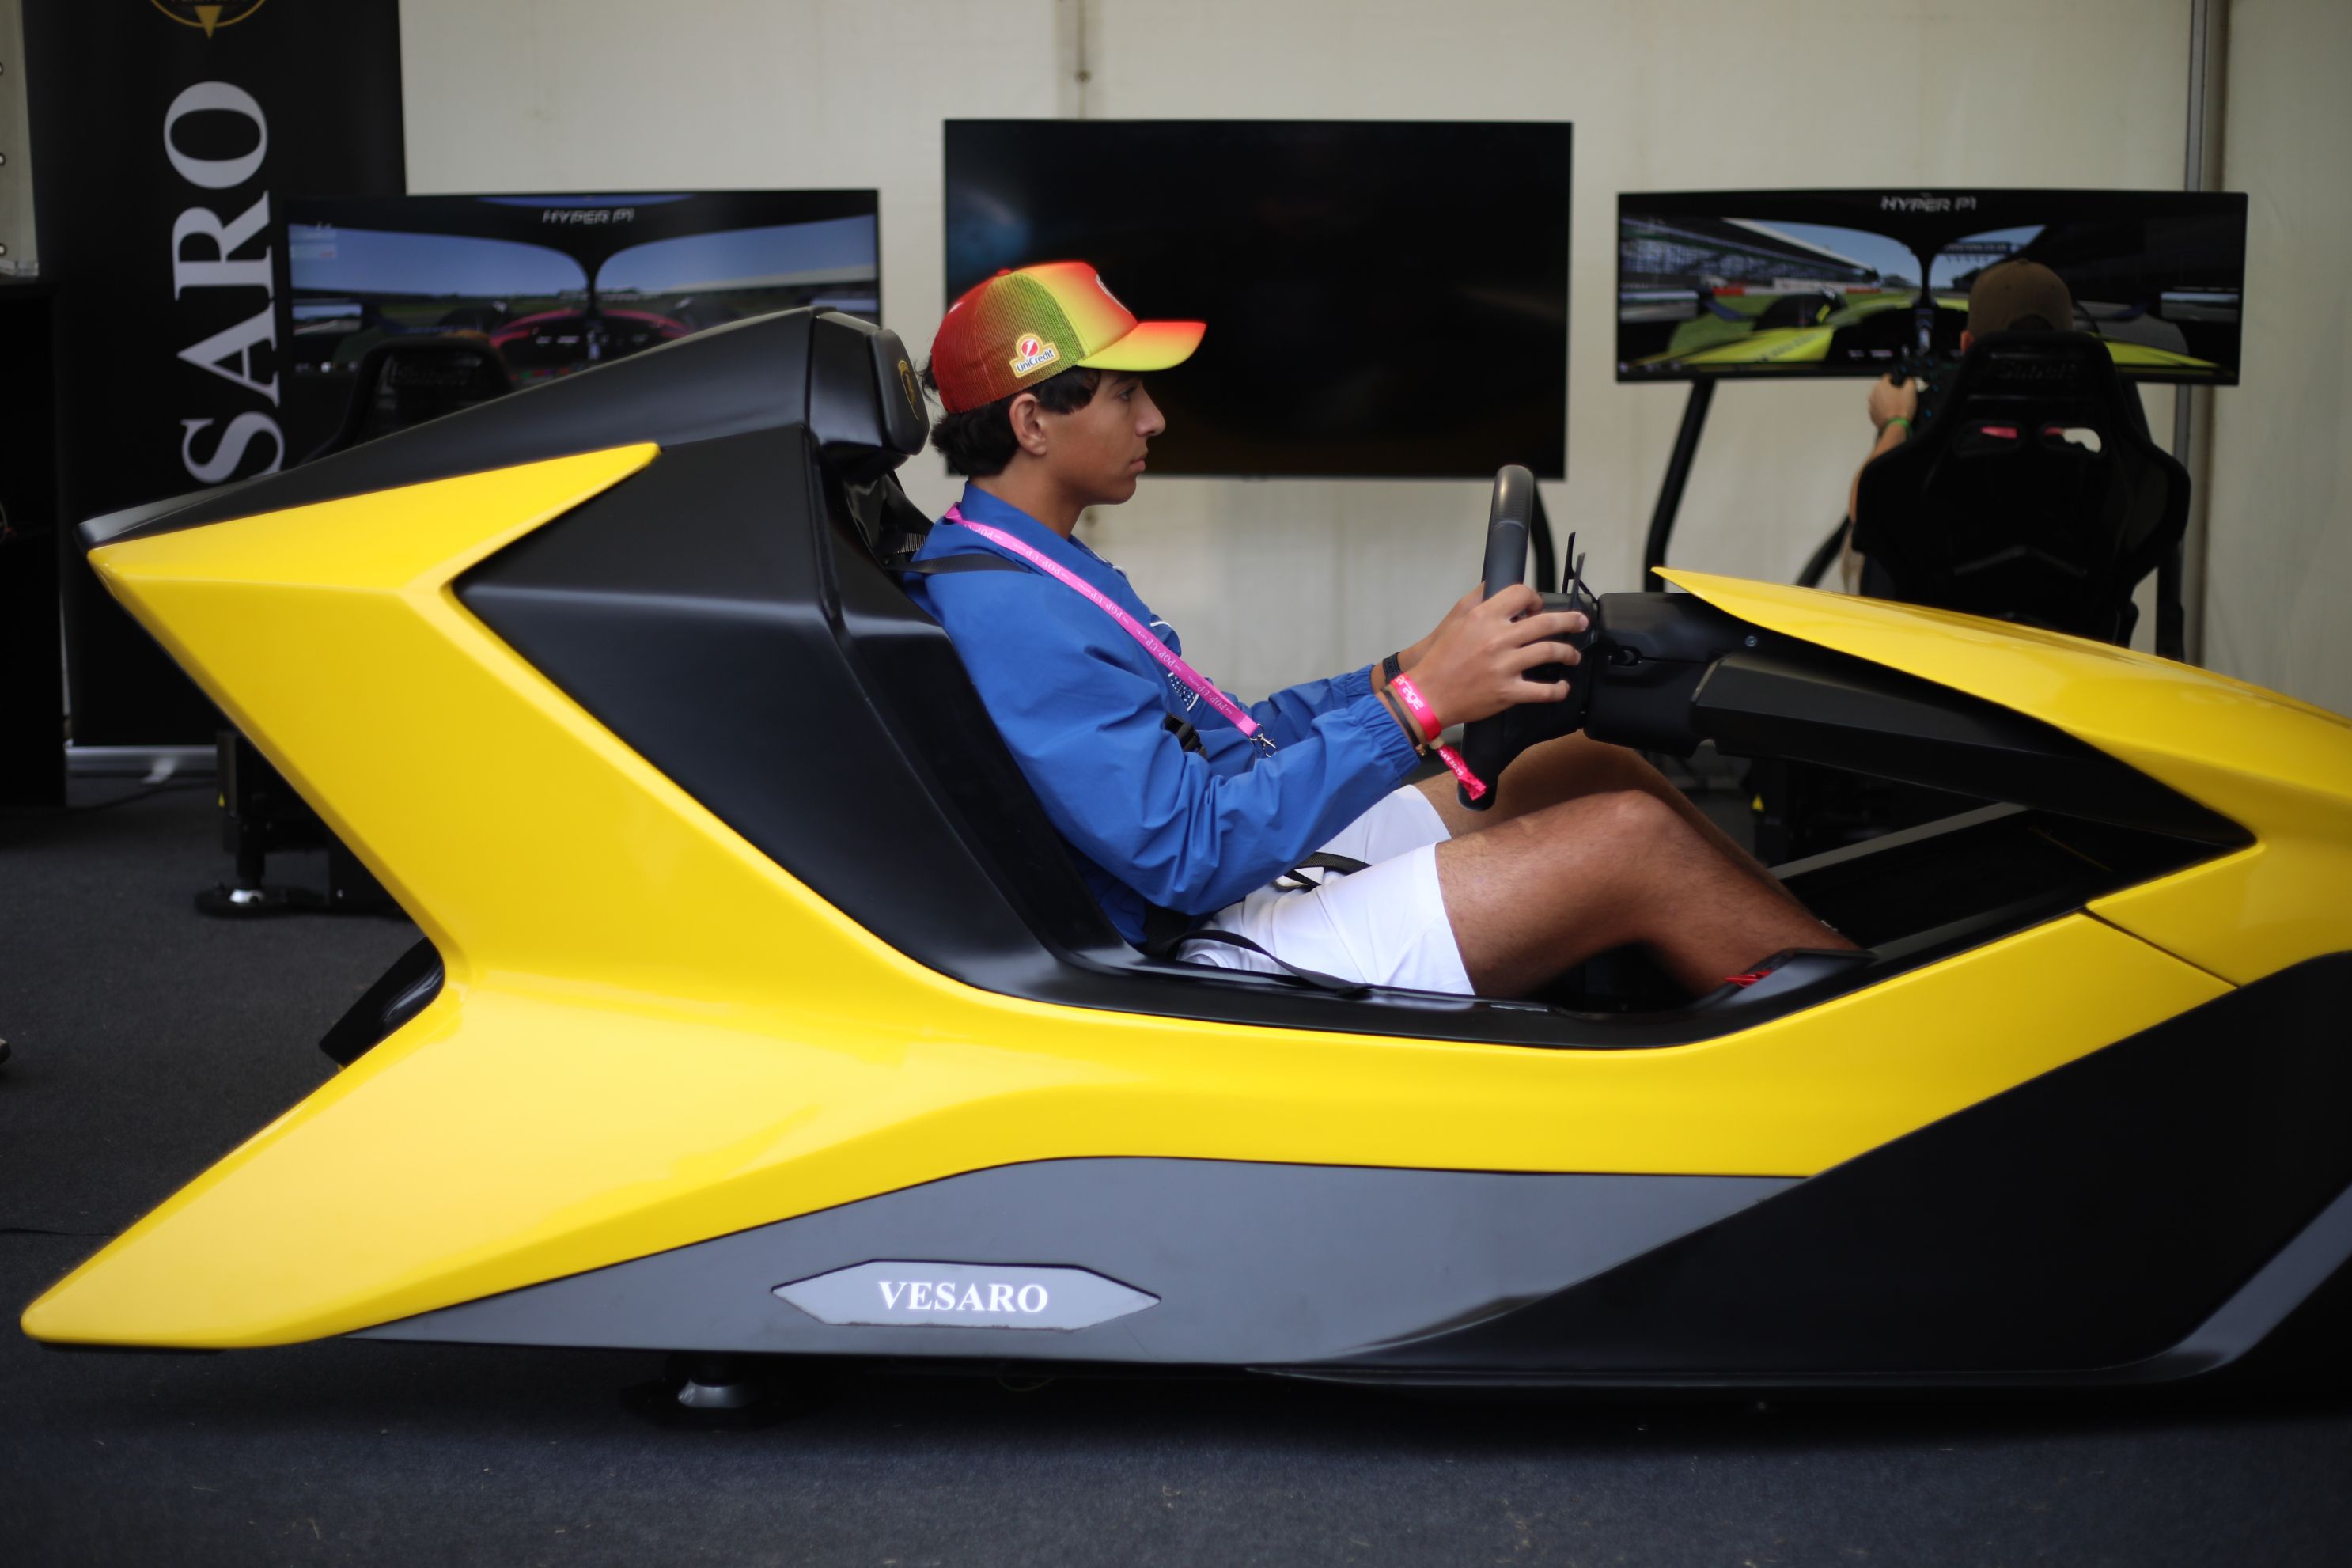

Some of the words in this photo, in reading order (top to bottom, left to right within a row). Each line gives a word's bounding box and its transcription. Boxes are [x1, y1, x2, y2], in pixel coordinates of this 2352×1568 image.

[1880, 196, 1951, 212] HYPER
[543, 209, 609, 225] HYPER
[163, 81, 285, 483] SARO
[1016, 349, 1055, 372] UniCredit
[1146, 638, 1176, 667] POP-UP
[1197, 685, 1227, 711] POP-UP
[1449, 760, 1464, 777] 2025
[878, 1281, 1049, 1314] VESARO
